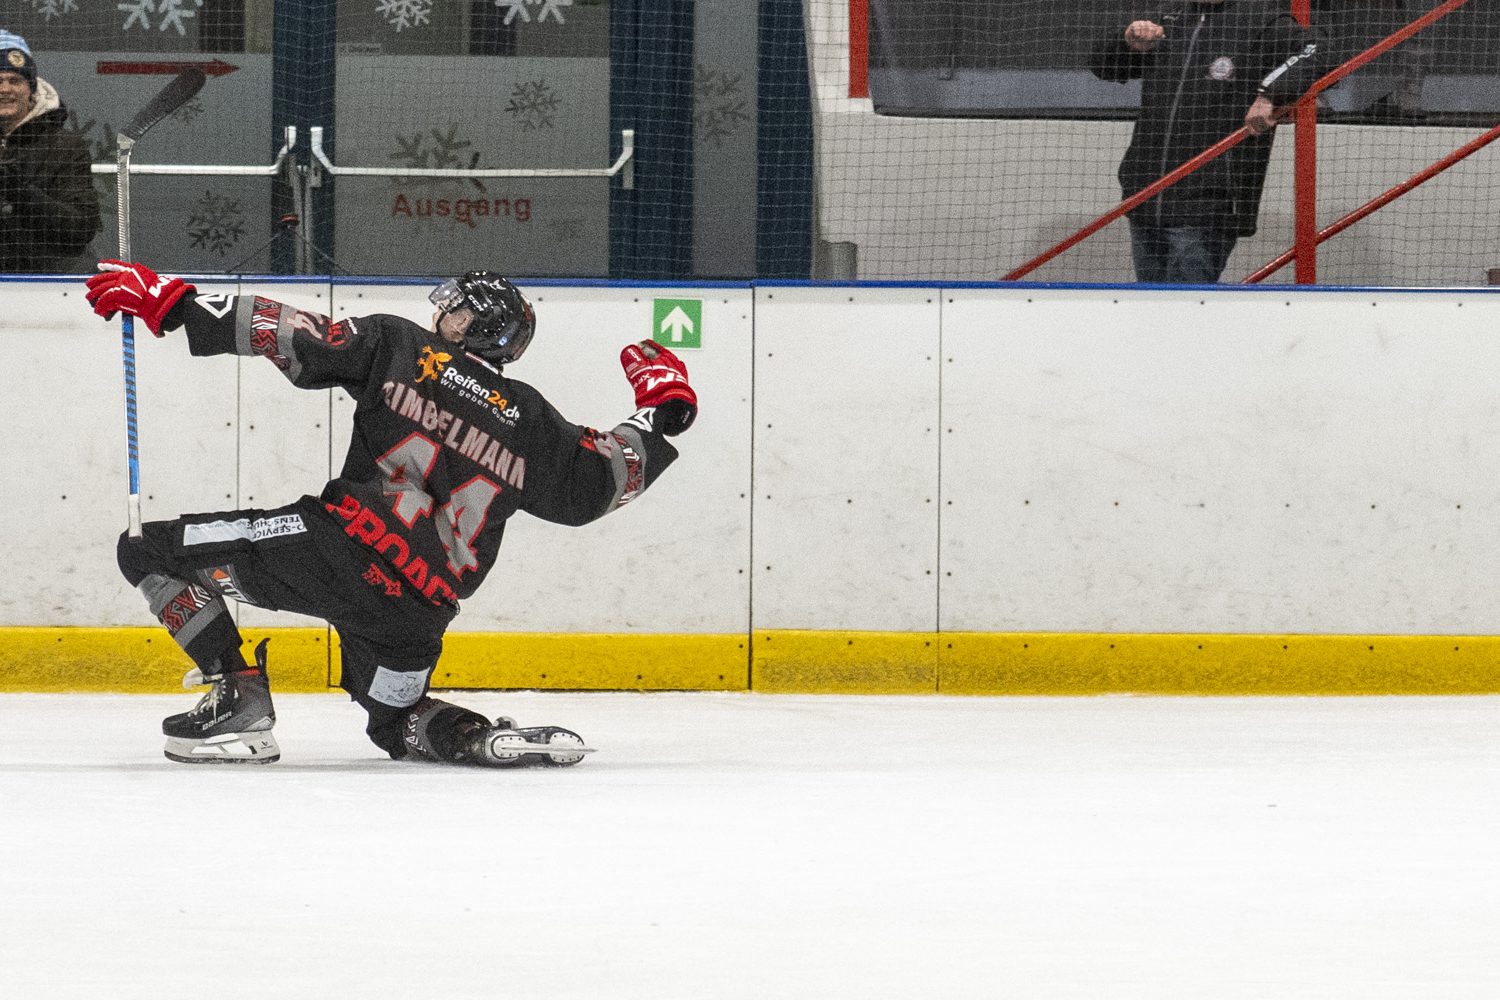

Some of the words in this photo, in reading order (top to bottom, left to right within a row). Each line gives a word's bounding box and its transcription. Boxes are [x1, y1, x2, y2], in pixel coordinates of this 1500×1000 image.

[392, 193, 532, 223] Ausgang
[440, 377, 456, 391] Wir
[458, 388, 489, 410] geben
[376, 431, 503, 583] 44
